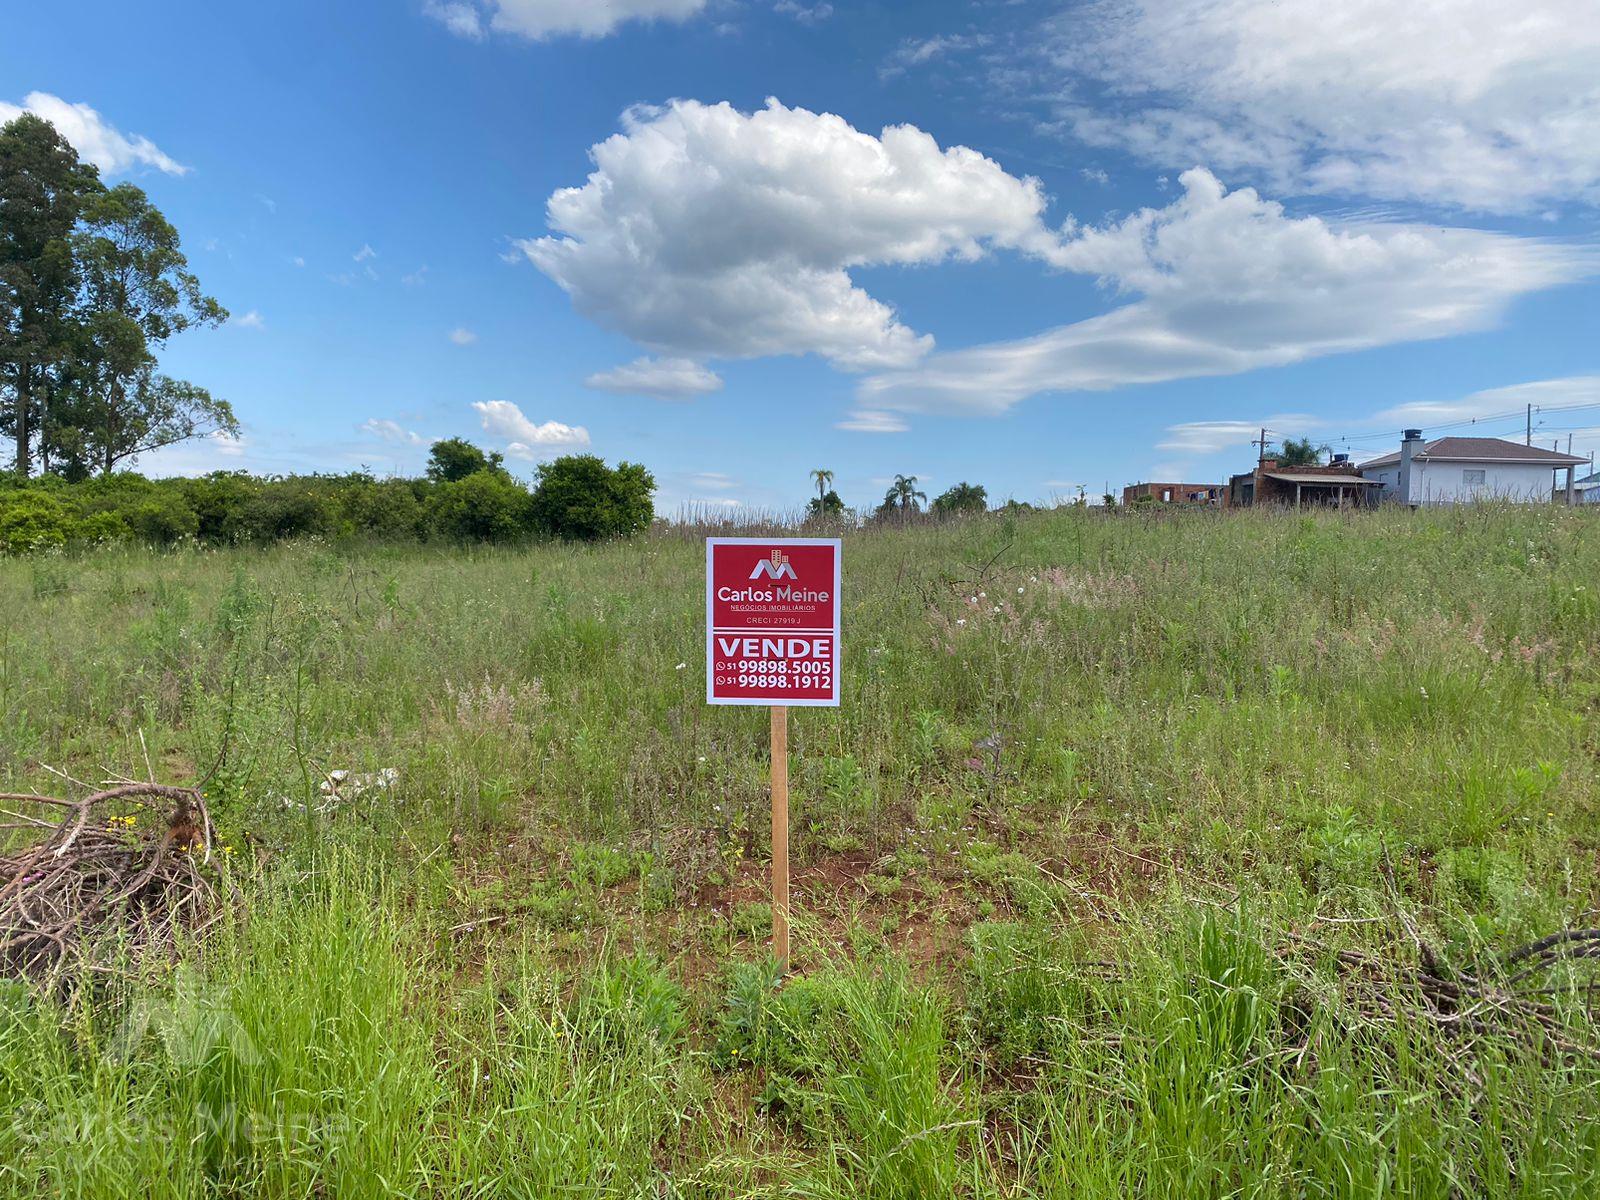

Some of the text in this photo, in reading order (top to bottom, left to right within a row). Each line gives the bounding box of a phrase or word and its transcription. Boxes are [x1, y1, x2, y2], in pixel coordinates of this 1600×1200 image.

[718, 587, 829, 602] Carlos Meine
[718, 638, 830, 658] VENDE
[727, 660, 831, 674] 51 99898.5005
[727, 675, 831, 689] 51 99898.1912
